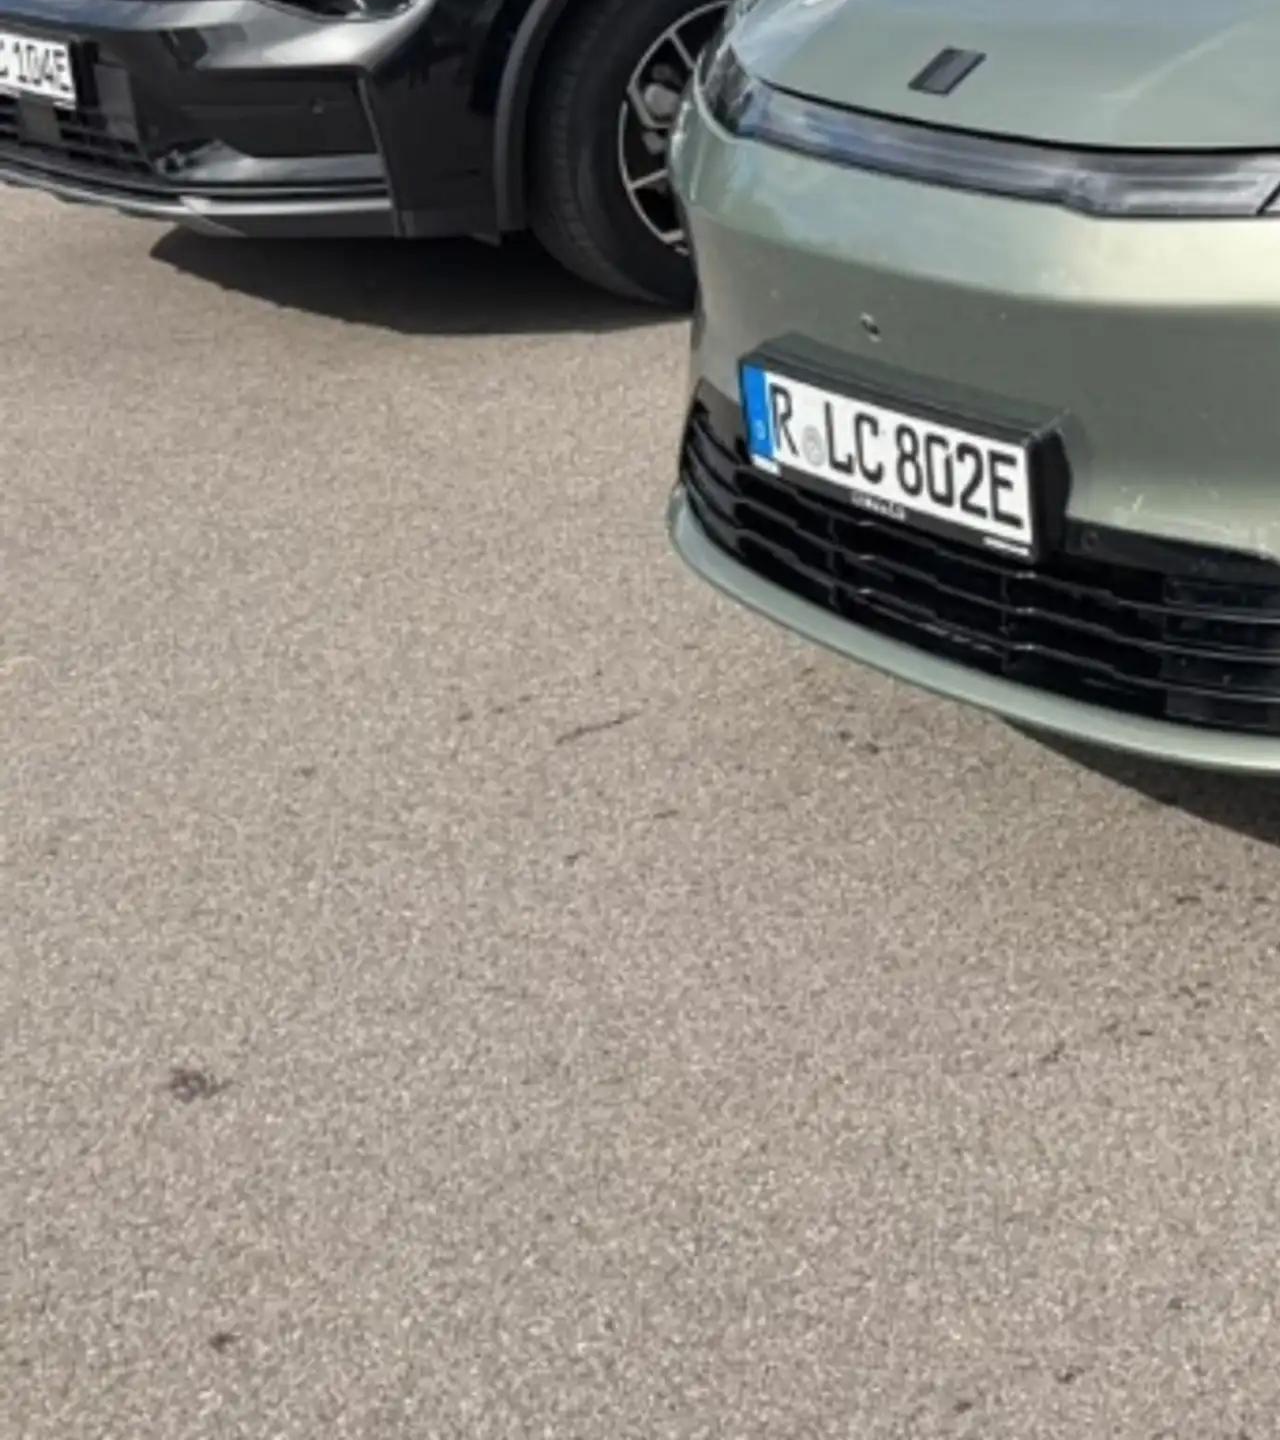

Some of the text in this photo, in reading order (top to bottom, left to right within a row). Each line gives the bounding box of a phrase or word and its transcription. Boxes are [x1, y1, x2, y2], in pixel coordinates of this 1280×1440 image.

[768, 381, 1025, 530] R LC 802E
